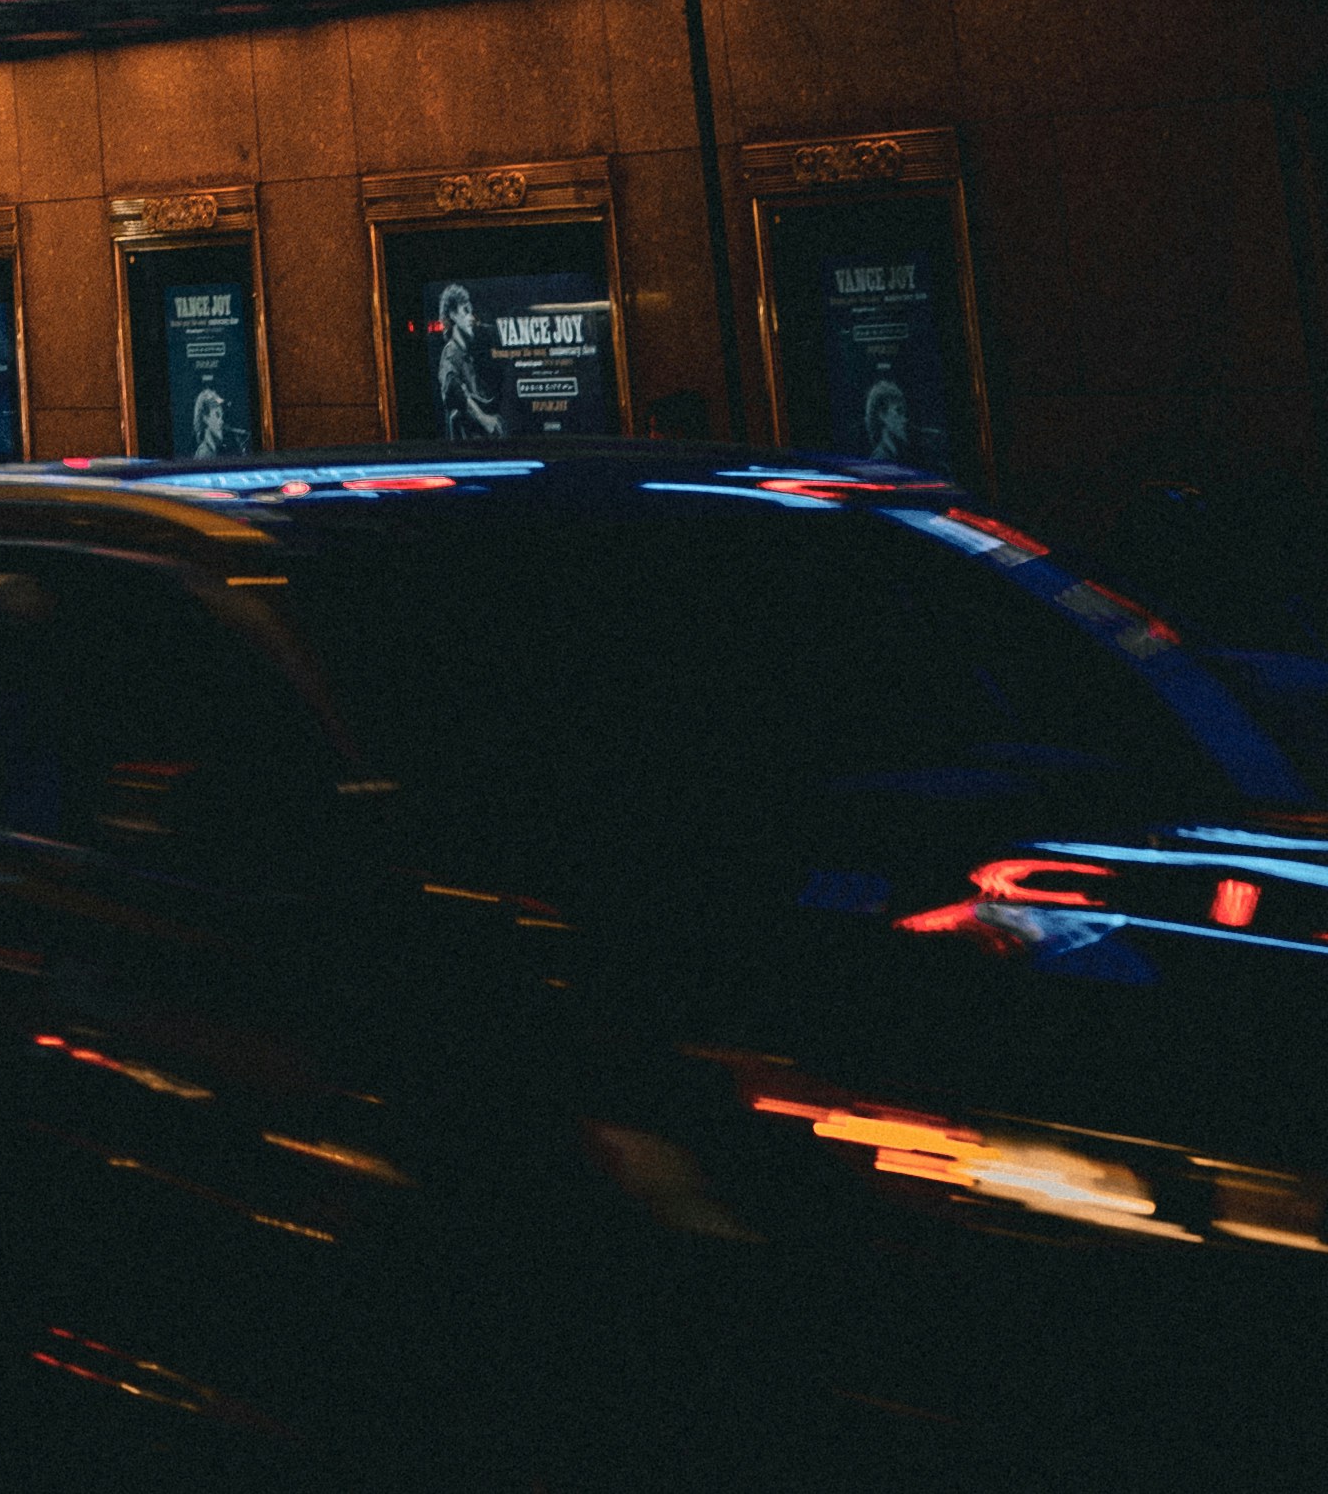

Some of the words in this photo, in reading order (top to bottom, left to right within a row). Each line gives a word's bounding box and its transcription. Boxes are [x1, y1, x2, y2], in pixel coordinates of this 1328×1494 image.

[835, 266, 886, 294] VANCE
[887, 264, 916, 291] JOY
[495, 315, 552, 347] VANCE
[552, 314, 584, 344] JOY
